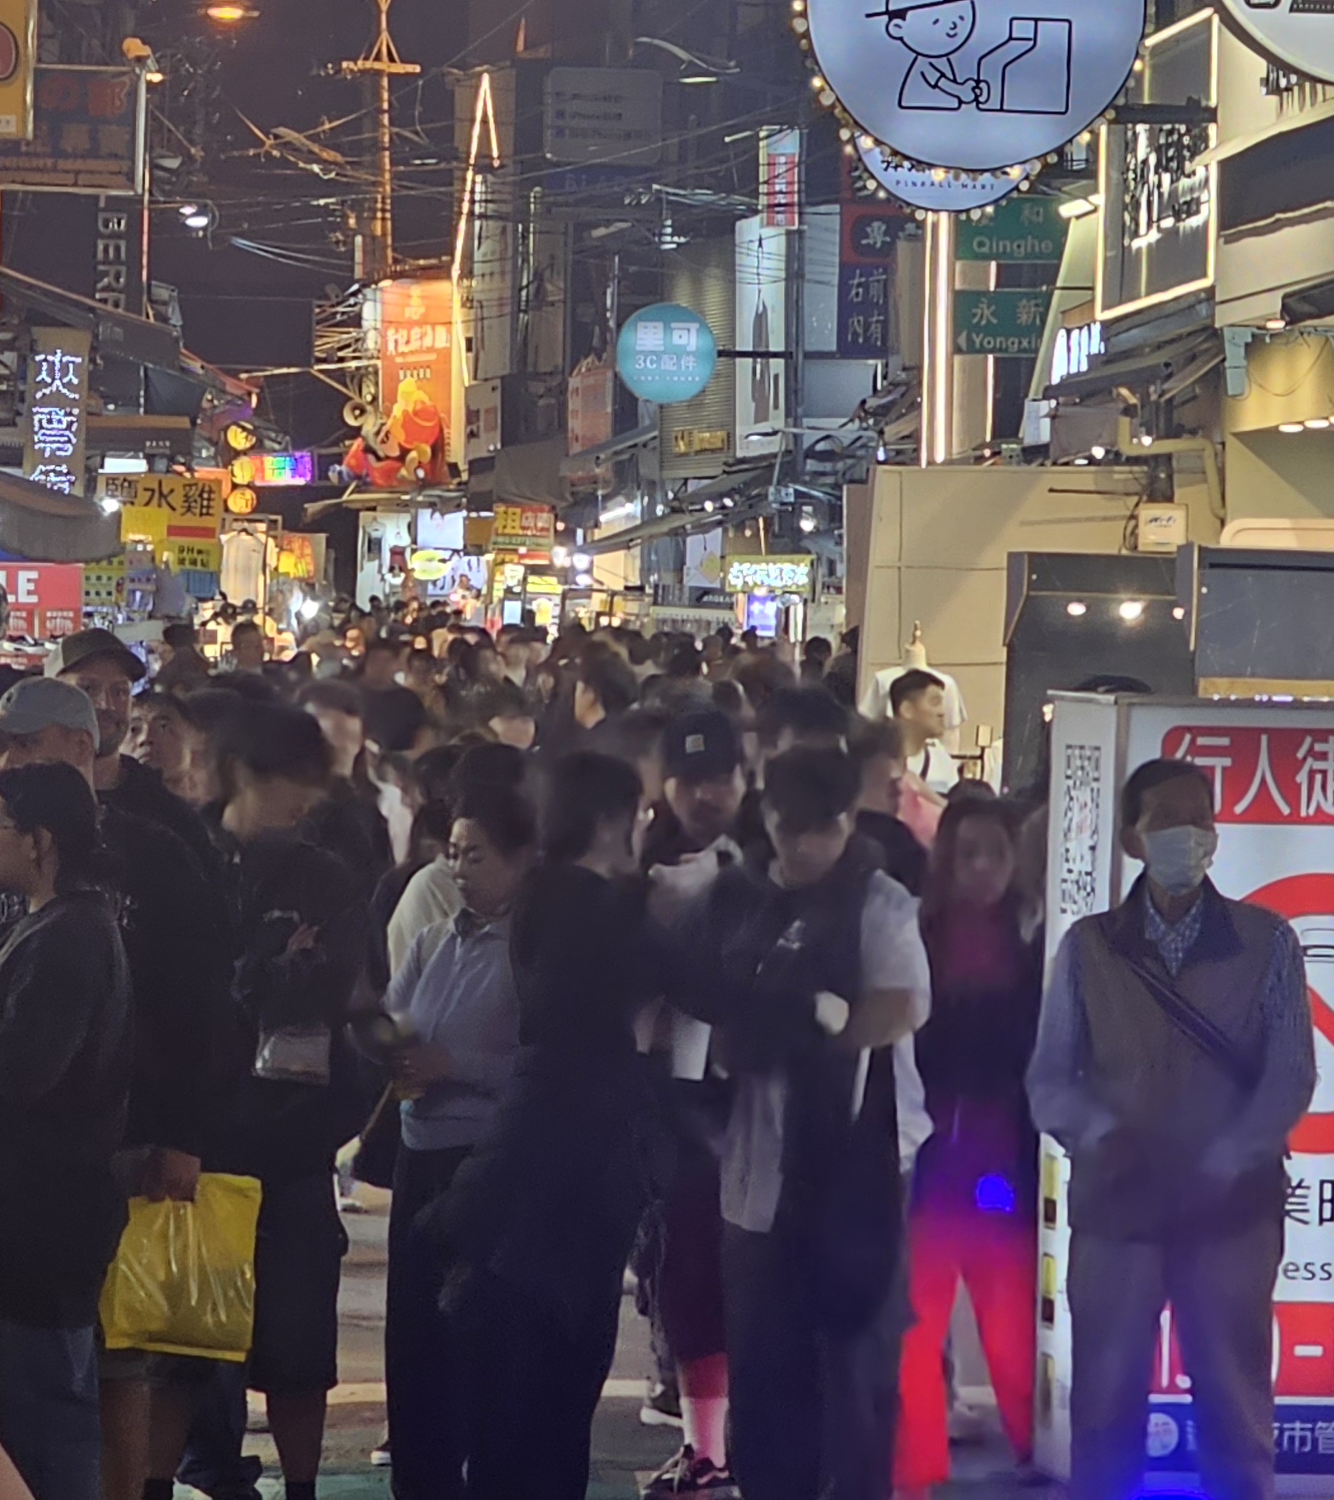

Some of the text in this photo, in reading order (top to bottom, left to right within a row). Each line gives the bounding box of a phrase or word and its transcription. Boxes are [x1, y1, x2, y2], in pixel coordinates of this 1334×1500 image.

[972, 235, 1053, 257] Qinghe
[972, 298, 1044, 326] 永新
[635, 320, 700, 352] 里可
